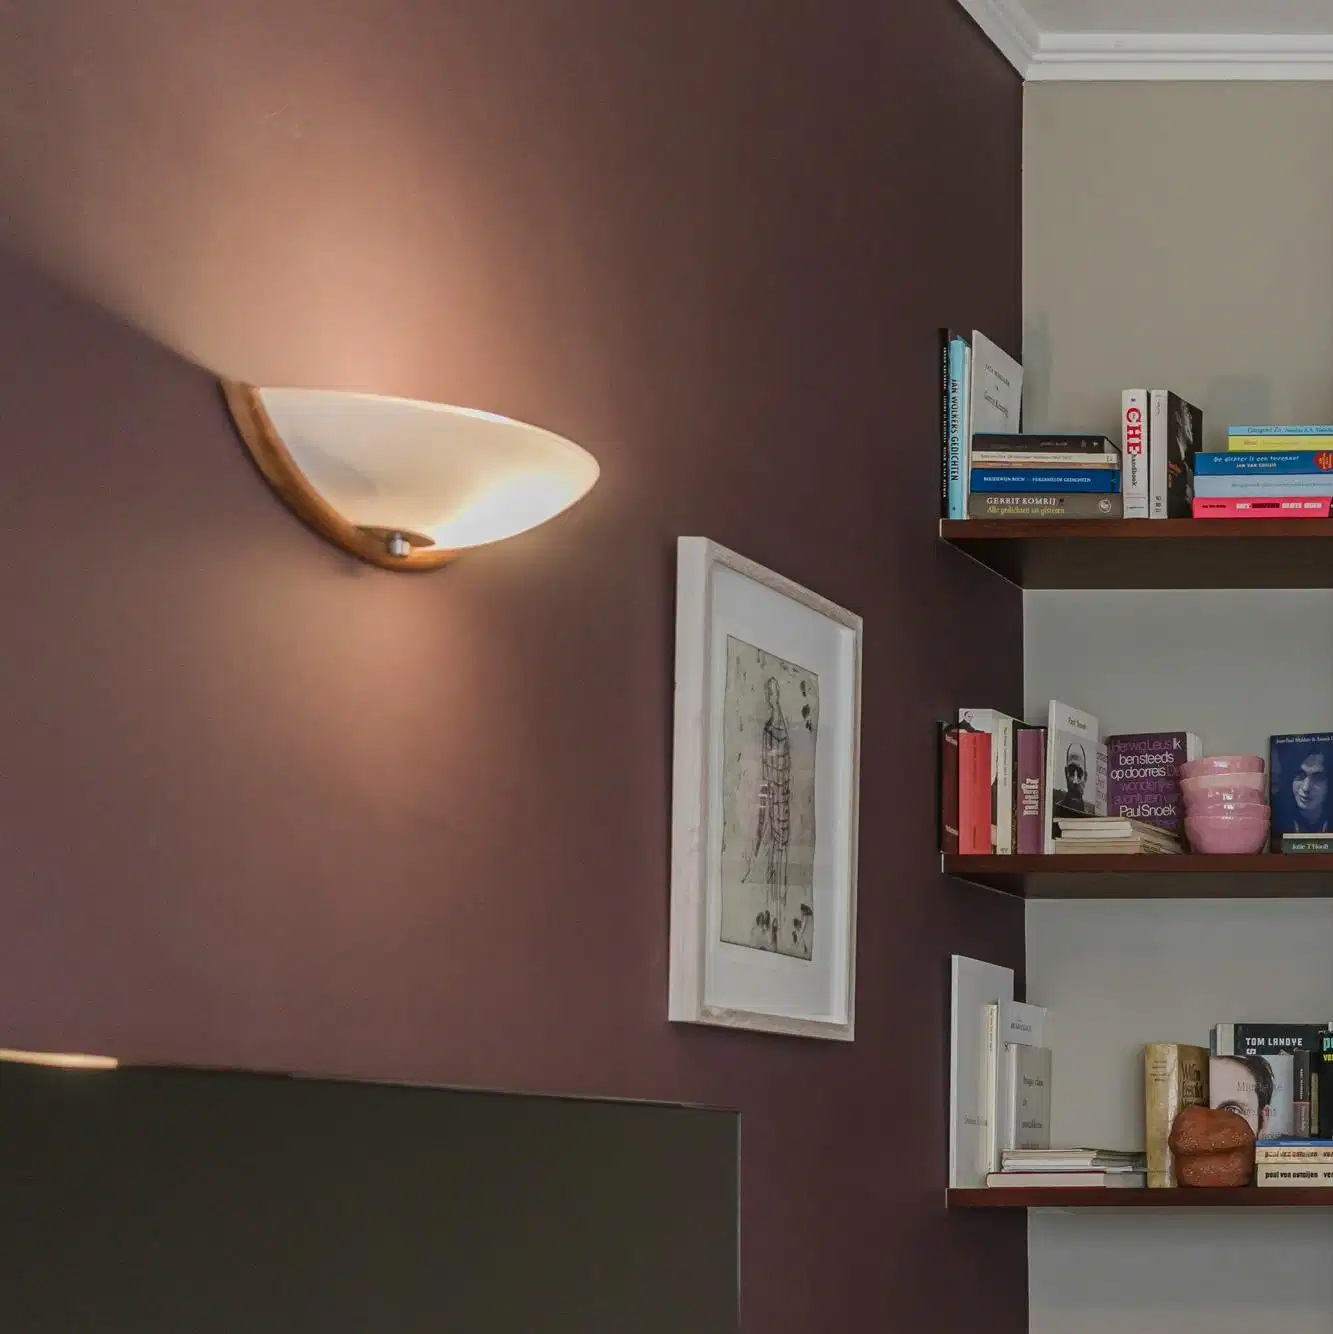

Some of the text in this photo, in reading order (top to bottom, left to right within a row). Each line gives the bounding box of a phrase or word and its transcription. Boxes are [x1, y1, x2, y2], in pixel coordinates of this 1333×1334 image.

[1126, 407, 1142, 455] CHE
[951, 436, 960, 481] GEDICHTEN
[986, 497, 1057, 505] GERRIT KOMRIJ
[1172, 737, 1182, 750] Ik
[1119, 751, 1175, 766] ben steeds
[1110, 769, 1124, 781] op
[1124, 765, 1167, 780] doorreis
[1120, 804, 1177, 818] Paul Snoek
[1245, 1037, 1265, 1046] TOM
[1265, 1171, 1280, 1179] paul
